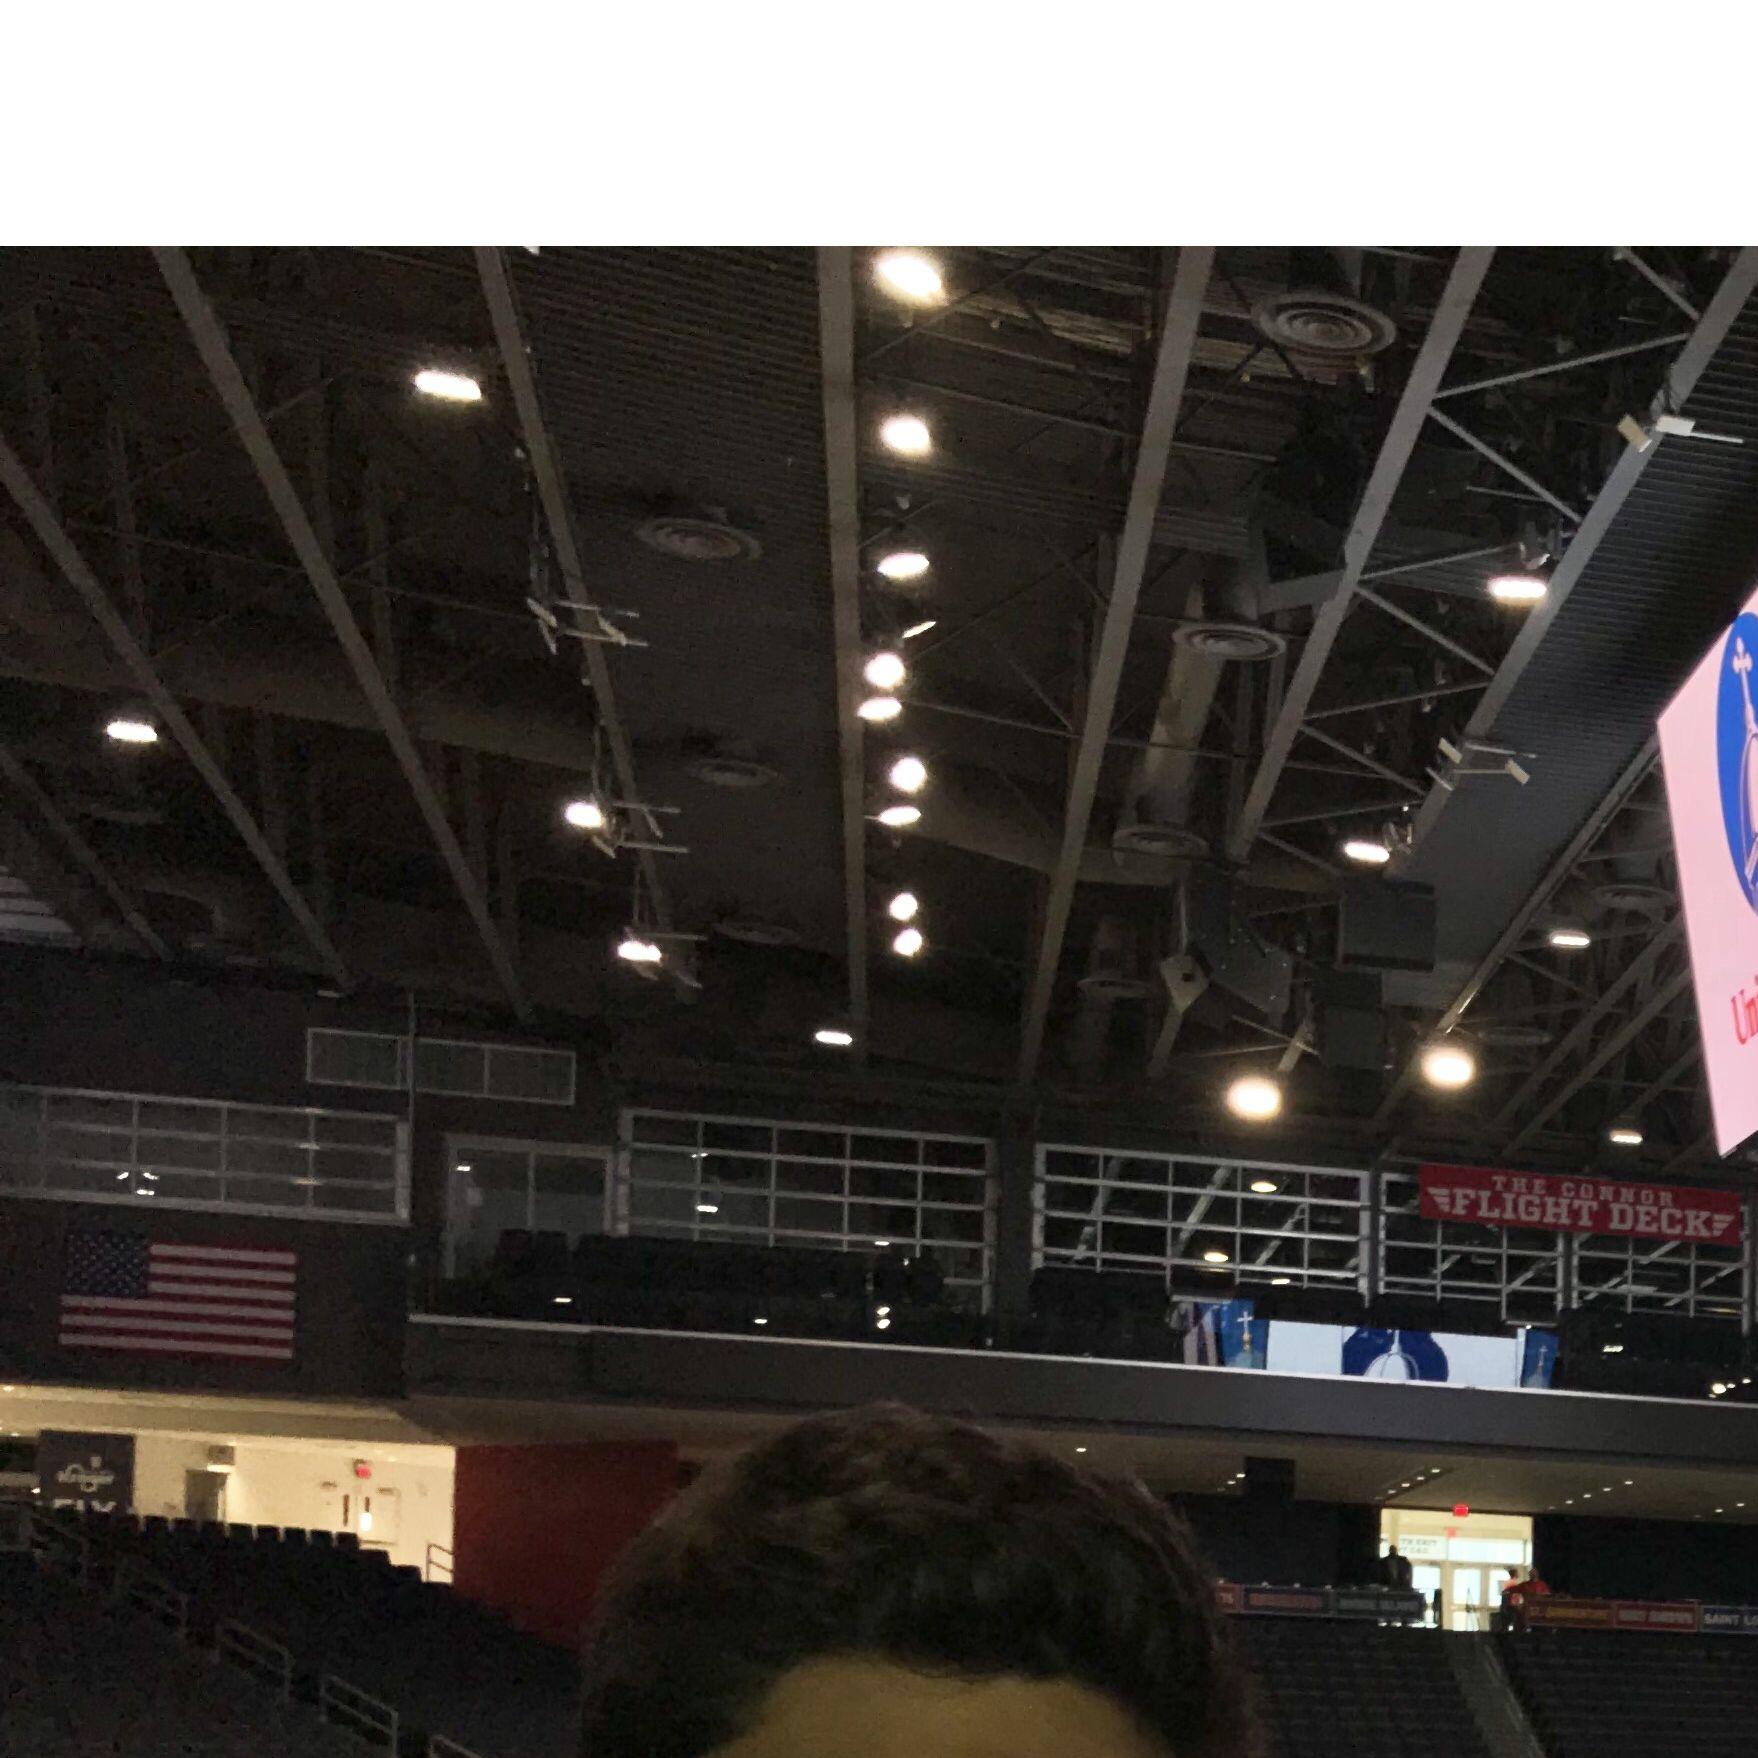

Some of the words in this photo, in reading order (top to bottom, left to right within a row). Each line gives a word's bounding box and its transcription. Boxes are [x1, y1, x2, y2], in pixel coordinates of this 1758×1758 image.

[1491, 1175, 1546, 1195] THE
[1561, 1182, 1675, 1207] CONNOR
[1451, 1187, 1597, 1228] FLIGHT
[1610, 1204, 1716, 1238] DECK
